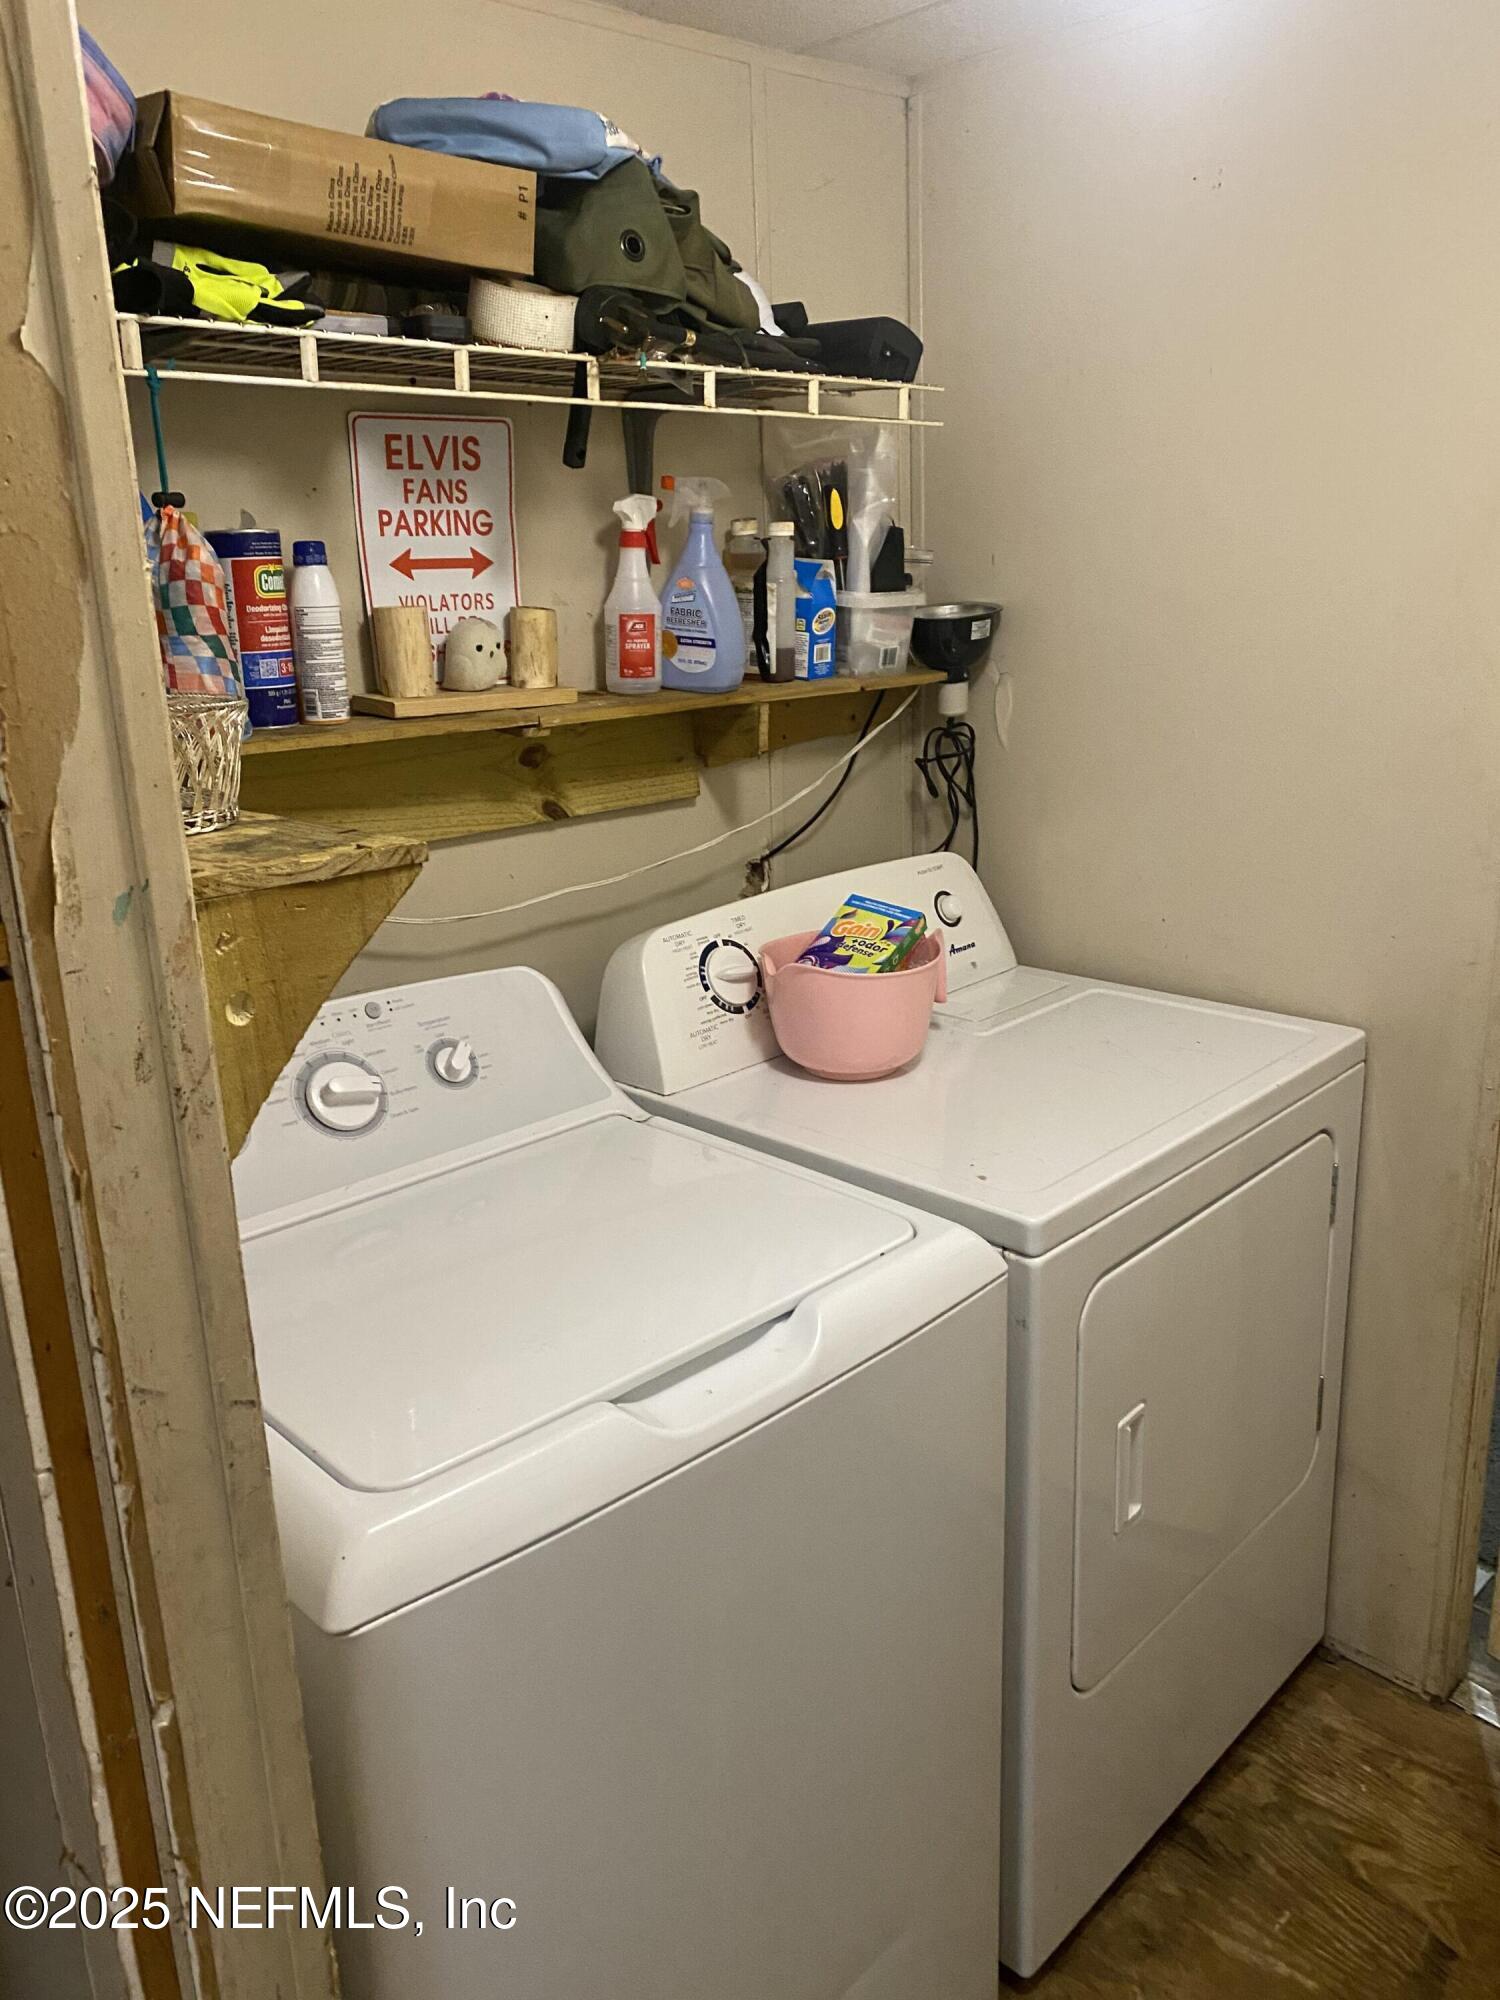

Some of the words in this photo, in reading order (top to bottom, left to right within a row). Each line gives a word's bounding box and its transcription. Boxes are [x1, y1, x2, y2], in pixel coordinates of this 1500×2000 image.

[518, 185, 529, 204] P1
[517, 211, 528, 221] #
[384, 433, 481, 472] ELVIS
[402, 478, 468, 505] FANS
[377, 509, 494, 537] PARKING
[398, 592, 495, 612] VIOLATORS
[670, 606, 704, 620] FABRIC
[665, 615, 708, 629] REFRESHER
[736, 921, 747, 929] DRY
[831, 919, 882, 941] Gain
[662, 930, 693, 944] AUTOMATIC
[674, 939, 686, 948] DRY
[838, 941, 875, 959] defense
[851, 938, 889, 954] +odor
[948, 941, 976, 958] Amana
[690, 1023, 720, 1039] AUTOMATIC
[701, 1034, 712, 1043] DRY
